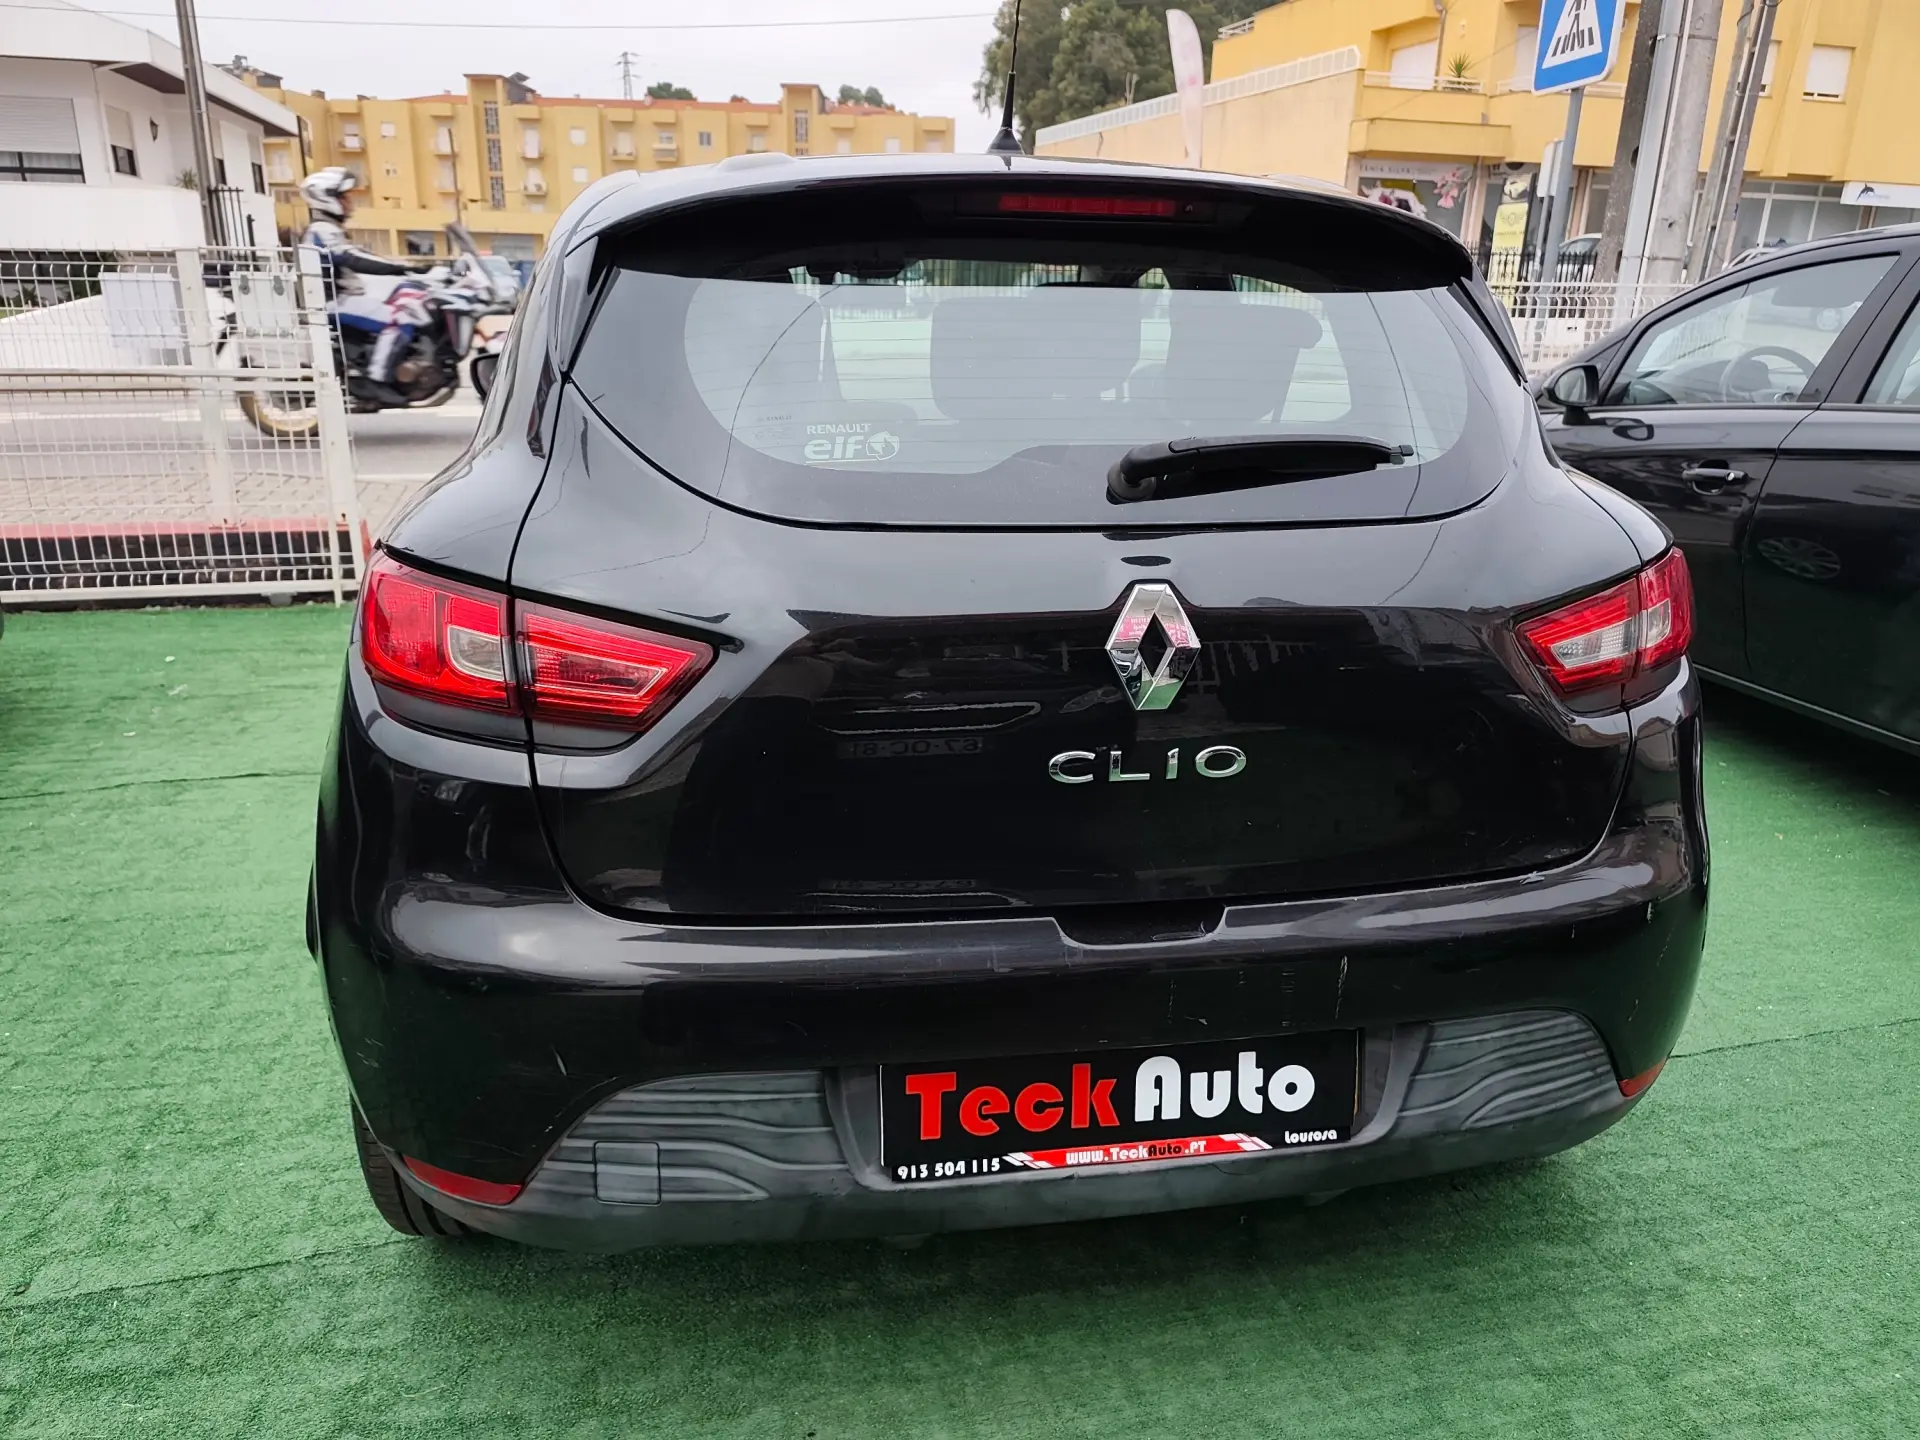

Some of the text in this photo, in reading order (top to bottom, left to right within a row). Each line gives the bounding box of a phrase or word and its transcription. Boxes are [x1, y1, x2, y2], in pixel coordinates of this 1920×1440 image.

[806, 423, 872, 435] RENAULT
[804, 435, 864, 460] elf
[1048, 745, 1247, 784] CLIO
[905, 1051, 1316, 1141] Teck Auto
[1284, 1129, 1338, 1144] Lourosa
[897, 1157, 1001, 1180] 913 504 115
